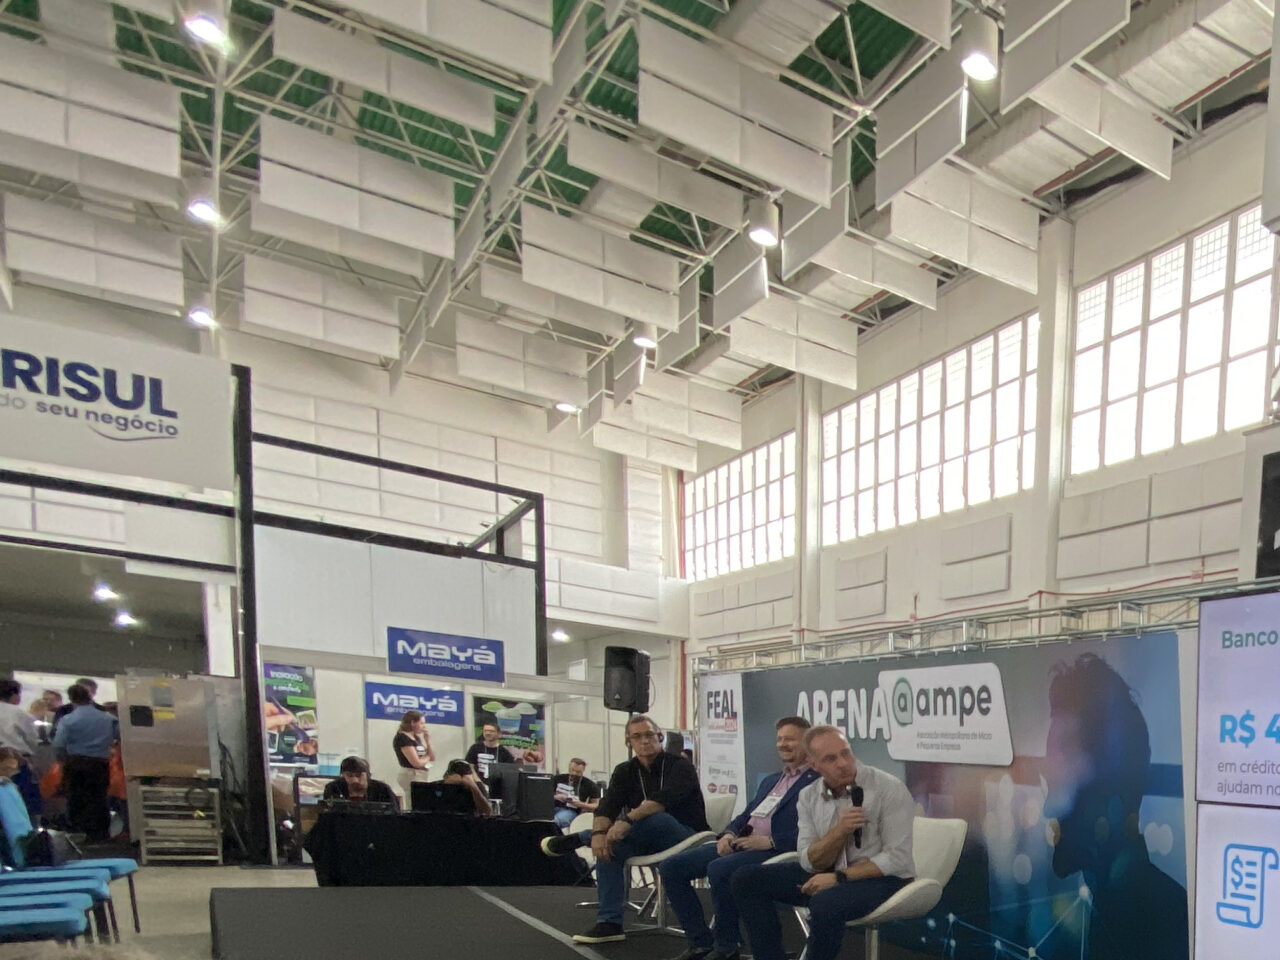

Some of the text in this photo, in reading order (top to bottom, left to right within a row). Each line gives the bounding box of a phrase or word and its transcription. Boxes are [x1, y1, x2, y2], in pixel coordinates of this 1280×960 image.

[2, 349, 178, 419] RISUL
[36, 401, 79, 418] seu
[85, 409, 178, 436] negócio
[1221, 629, 1278, 649] Banco
[413, 658, 482, 671] embalagens
[386, 706, 445, 718] embgens
[707, 689, 737, 719] FEAL
[797, 688, 891, 741] ARENA
[1219, 709, 1256, 749] R$
[1217, 761, 1237, 774] em
[1217, 779, 1263, 797] ajudam
